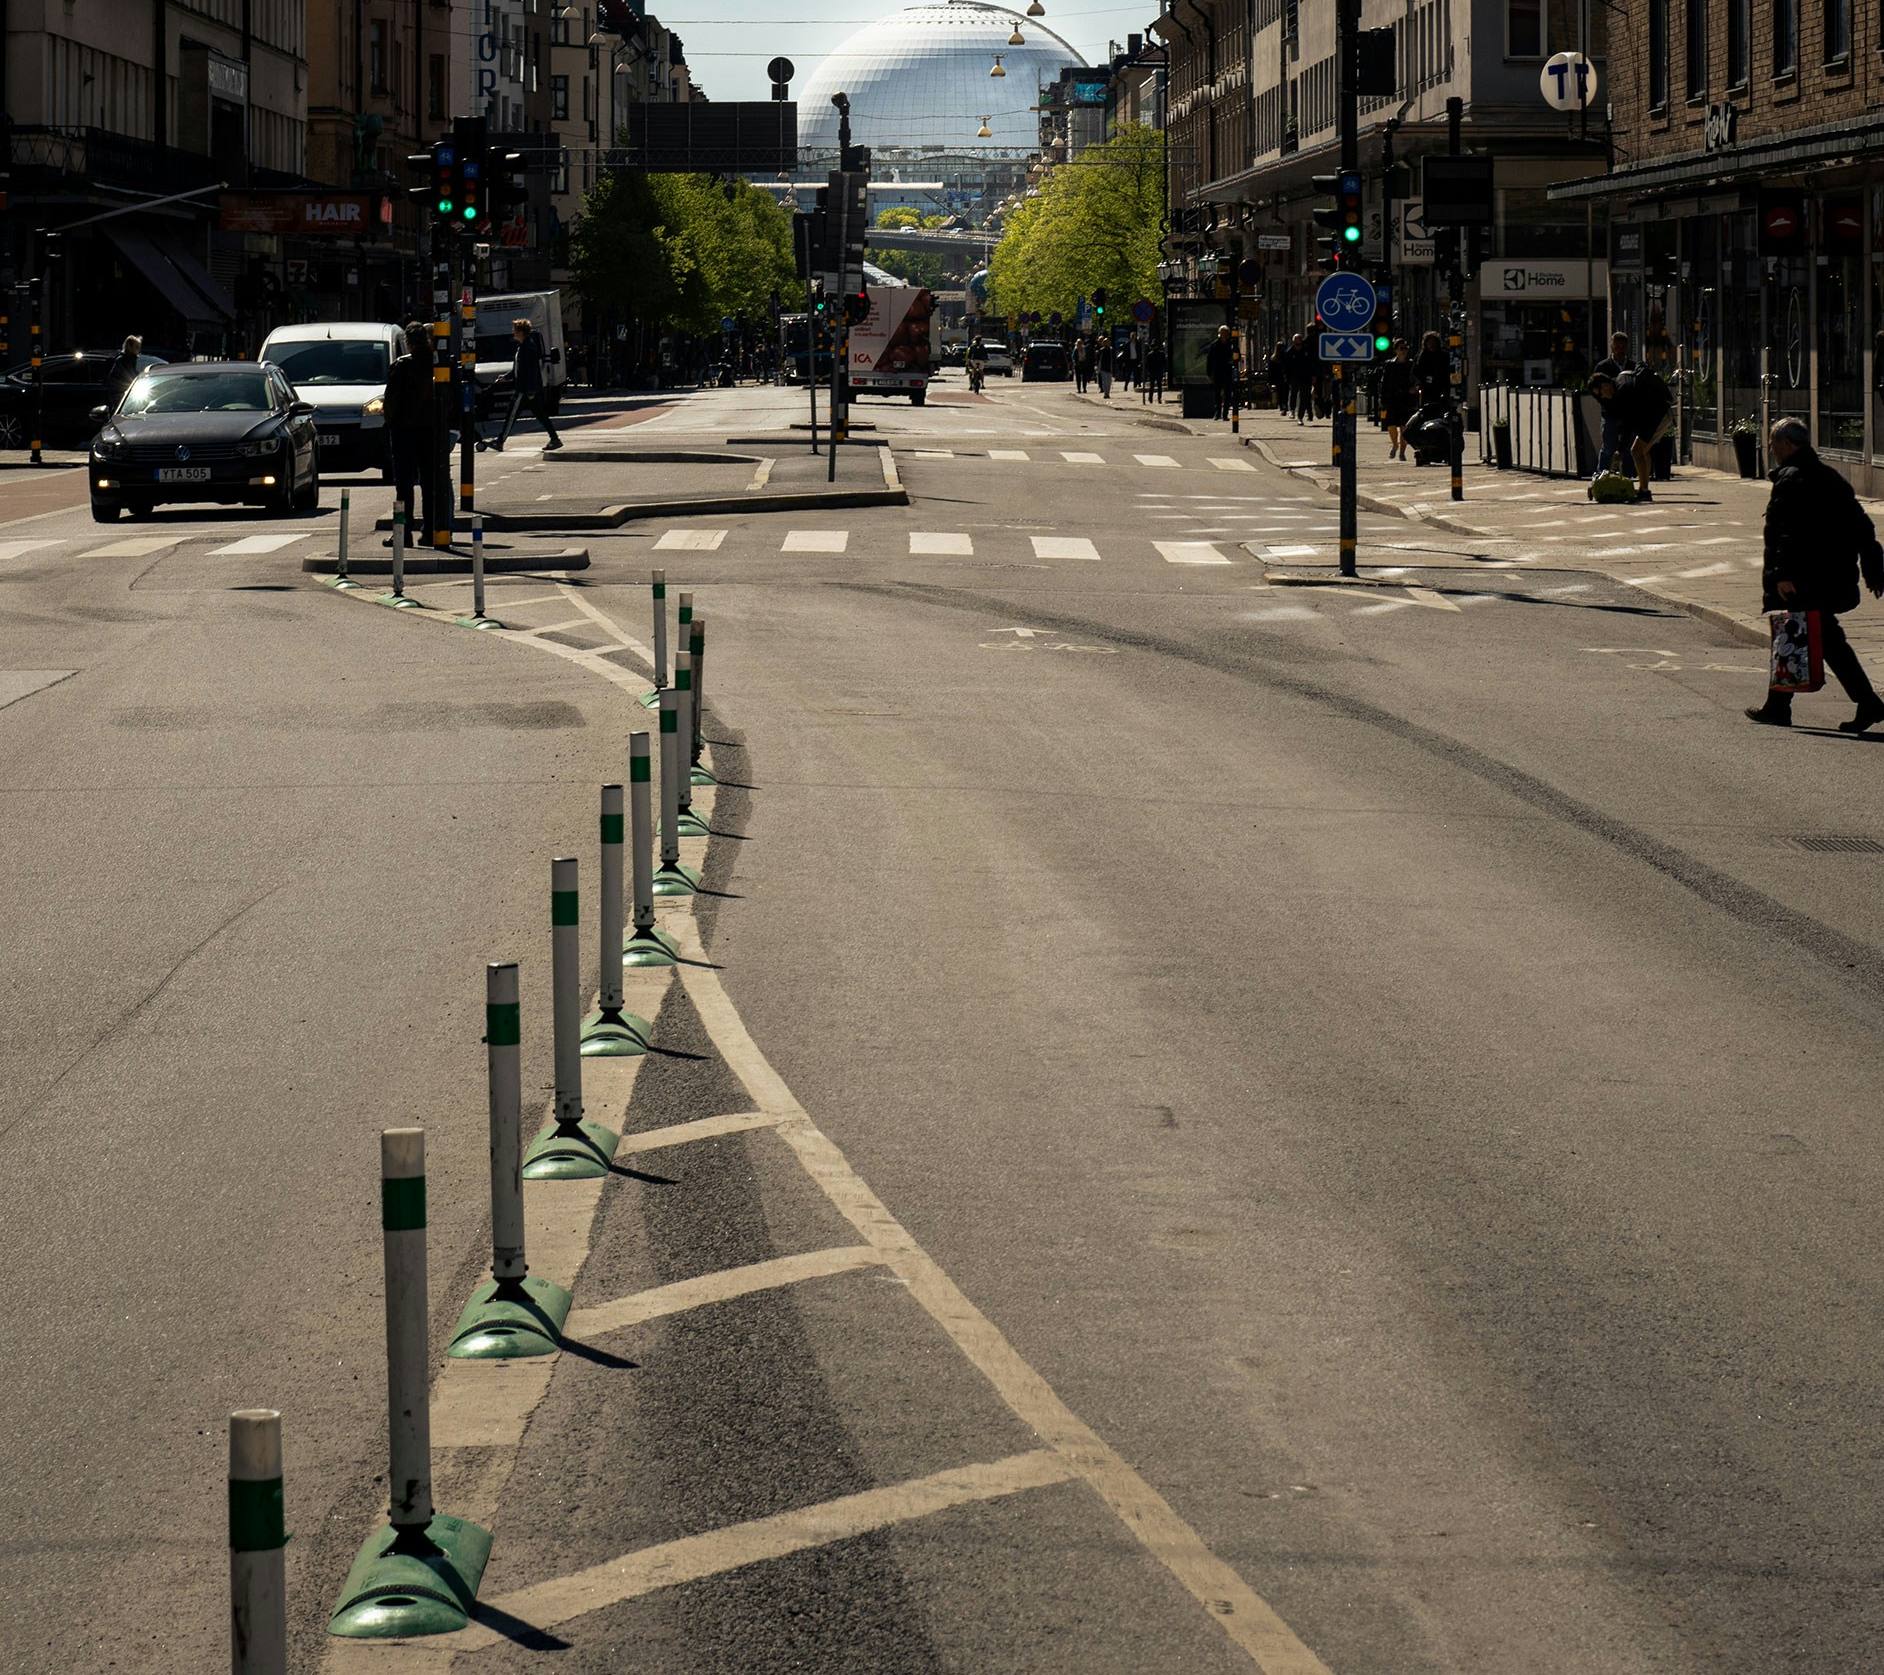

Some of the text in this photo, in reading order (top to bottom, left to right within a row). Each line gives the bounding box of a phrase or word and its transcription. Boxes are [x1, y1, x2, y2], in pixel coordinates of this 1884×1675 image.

[1548, 62, 1569, 100] T
[305, 203, 361, 221] HAIR
[1404, 243, 1435, 256] Hom
[1528, 272, 1566, 286] Home
[1084, 304, 1091, 313] P
[854, 353, 873, 364] ICA
[163, 468, 207, 478] YTA 505
